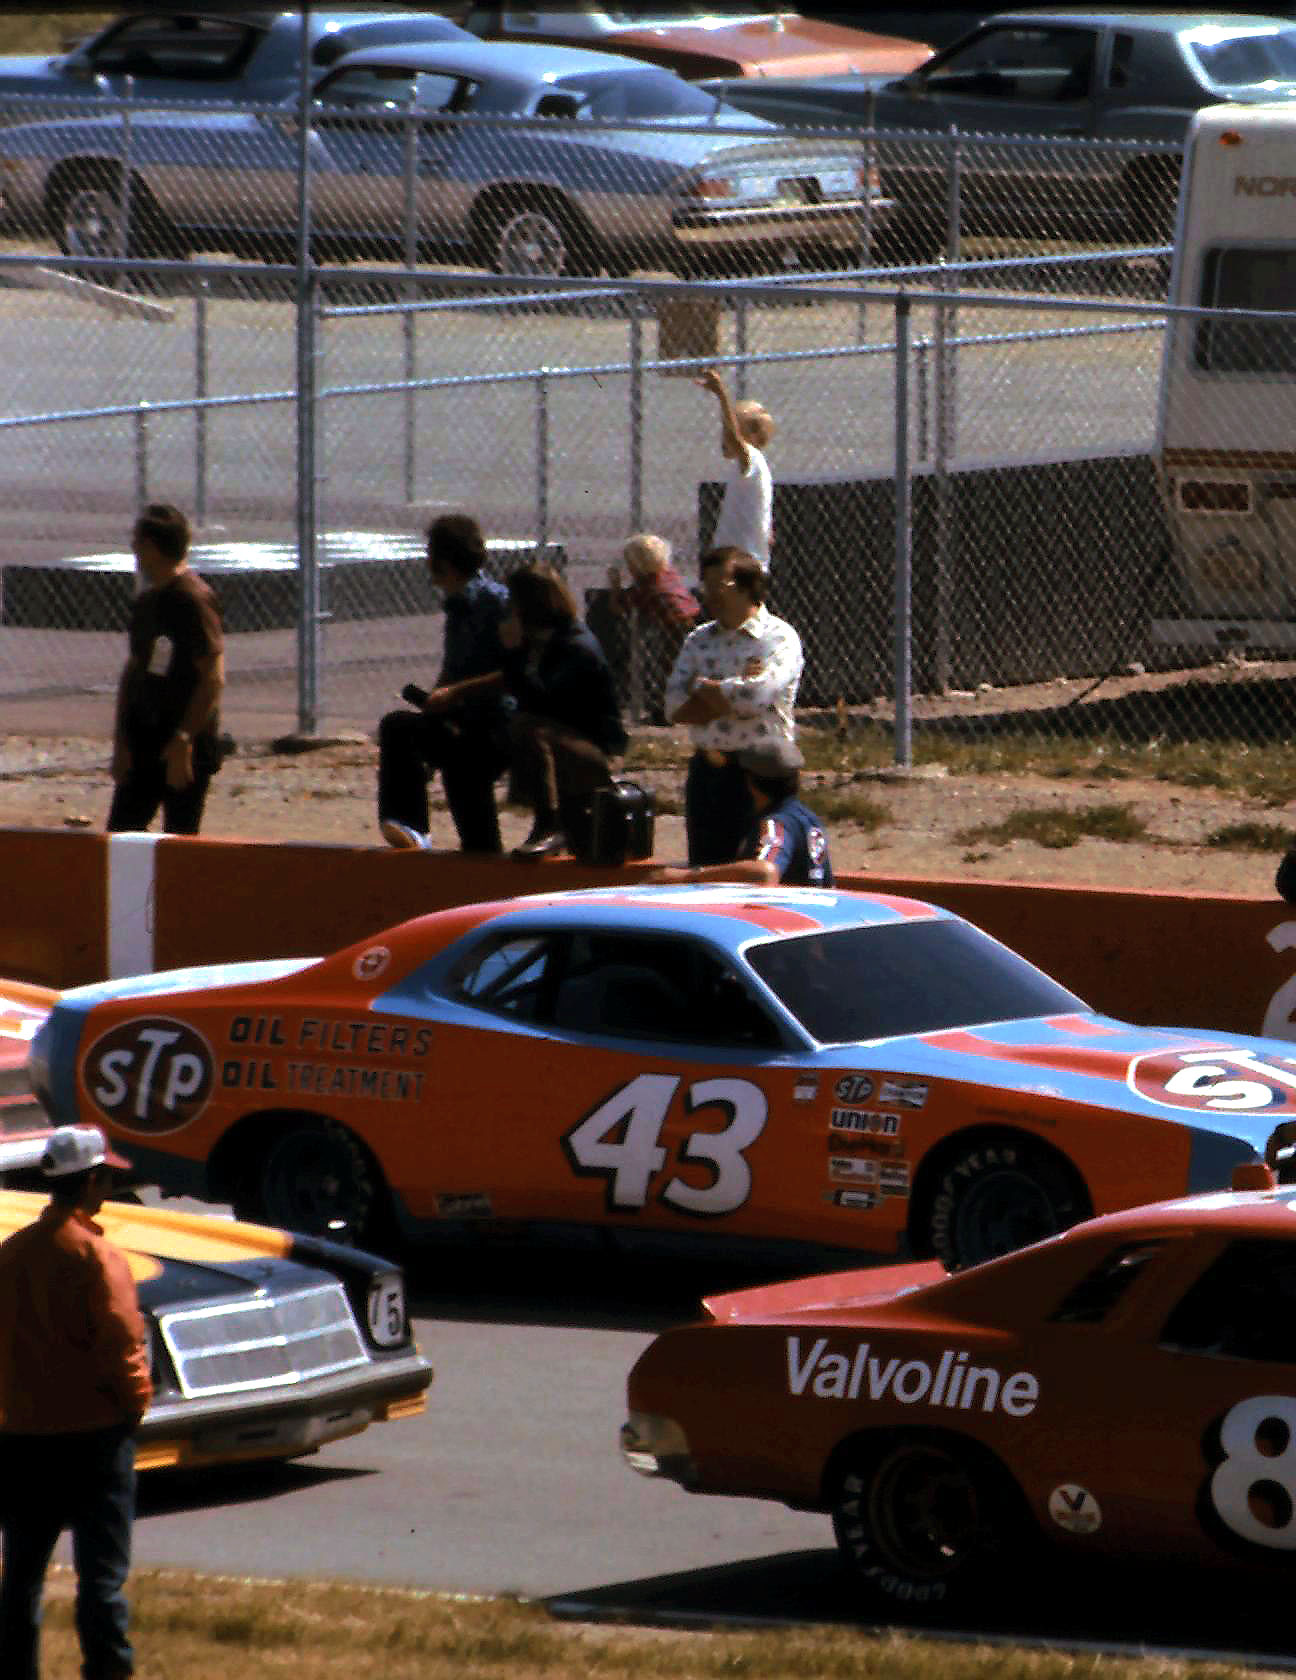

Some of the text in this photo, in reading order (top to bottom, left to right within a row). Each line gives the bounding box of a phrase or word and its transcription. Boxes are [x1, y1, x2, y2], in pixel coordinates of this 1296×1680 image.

[229, 1016, 434, 1057] OIL FILTERS
[95, 1028, 206, 1120] STP
[221, 1060, 426, 1101] OIL TREATMENT
[836, 1075, 875, 1104] STP
[567, 1073, 769, 1214] 43
[785, 1335, 1041, 1418] Valvoline
